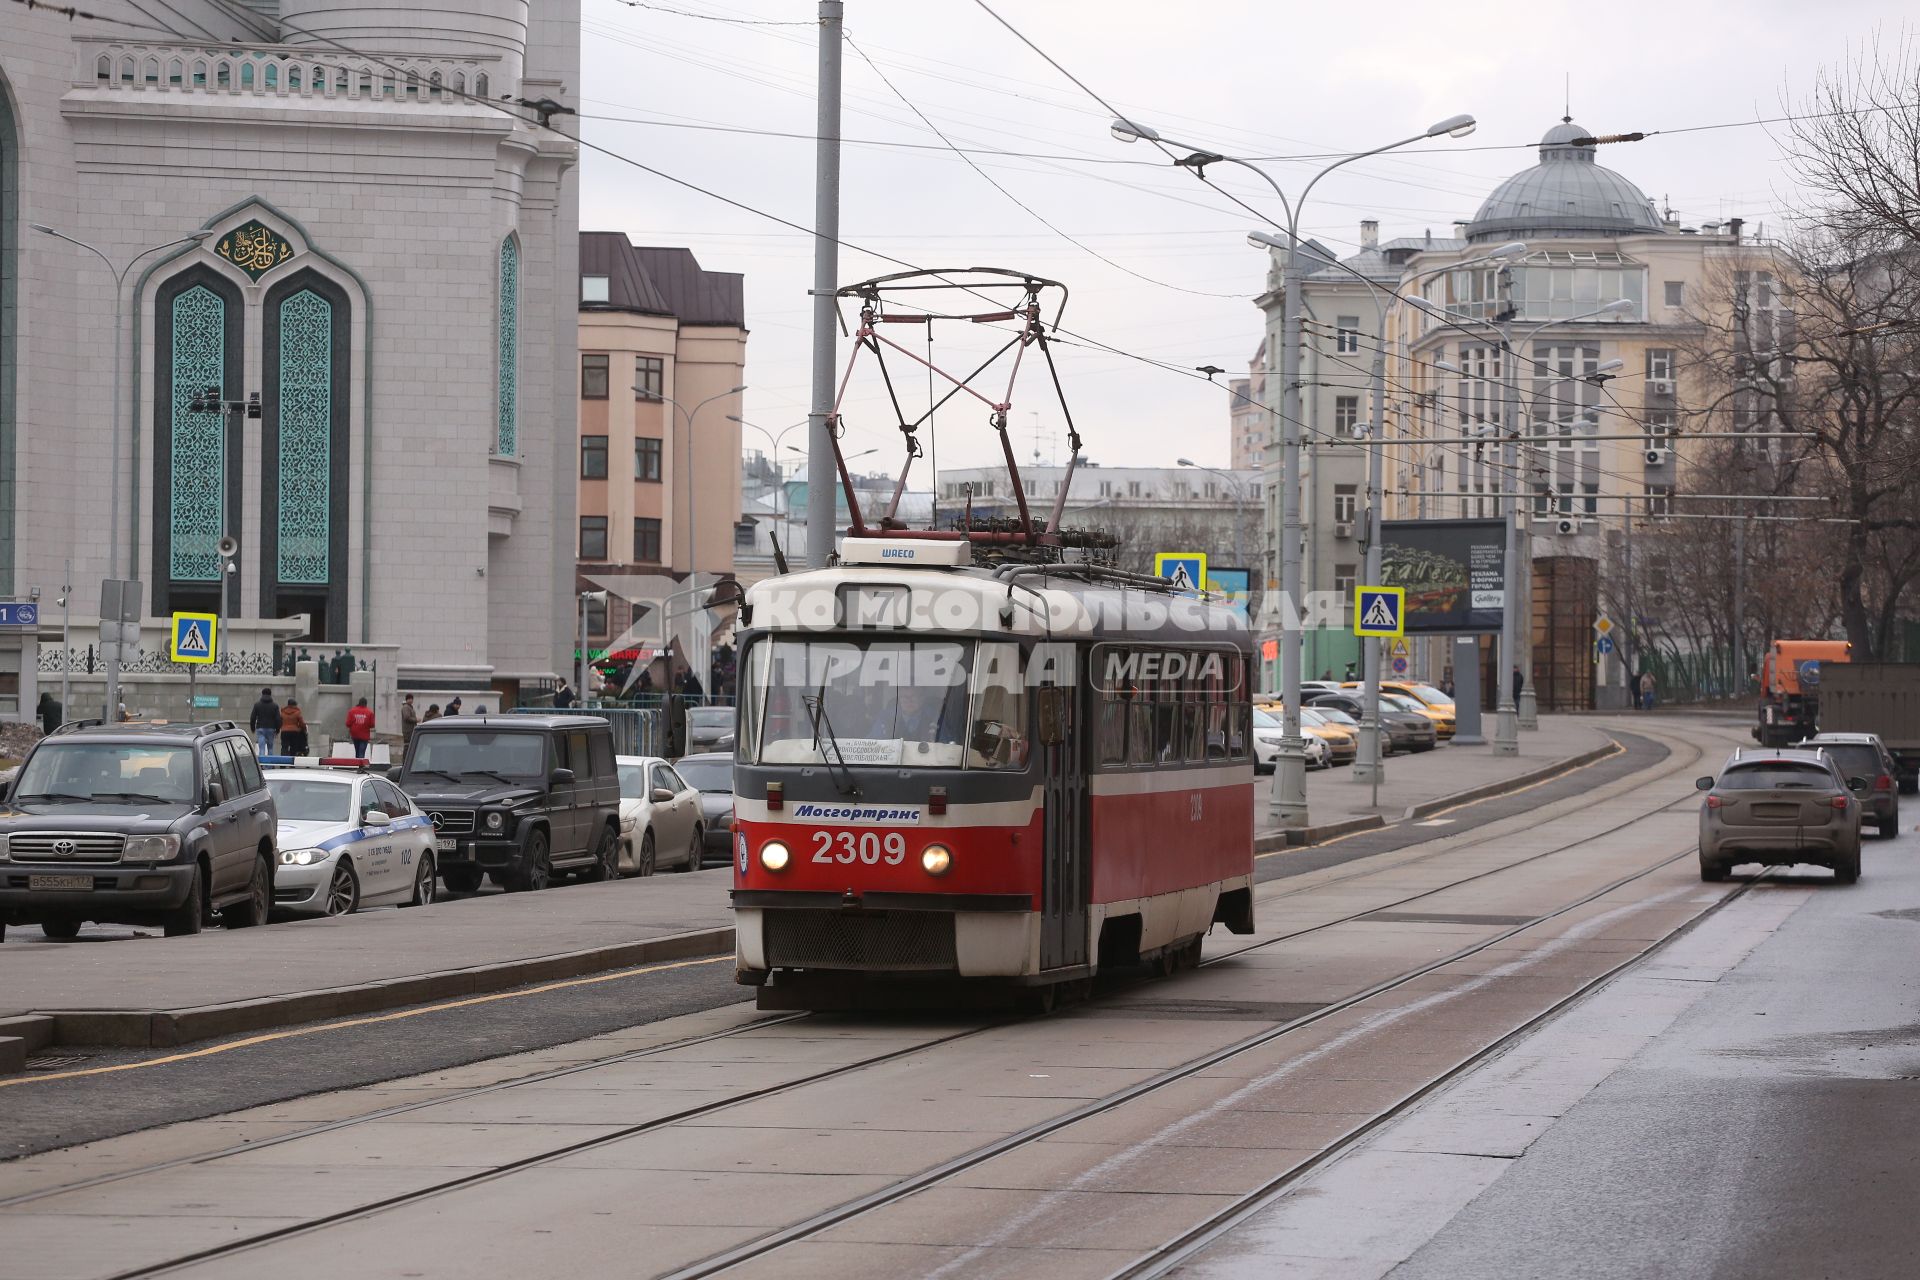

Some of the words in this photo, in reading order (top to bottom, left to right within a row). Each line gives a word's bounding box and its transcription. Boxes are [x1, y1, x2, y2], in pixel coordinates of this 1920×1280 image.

[882, 549, 915, 559] WAECO
[874, 592, 895, 622] 7
[1474, 594, 1501, 605] Gallery
[794, 805, 920, 821] Мосгортранс
[811, 830, 906, 866] 2309
[401, 848, 412, 865] 102
